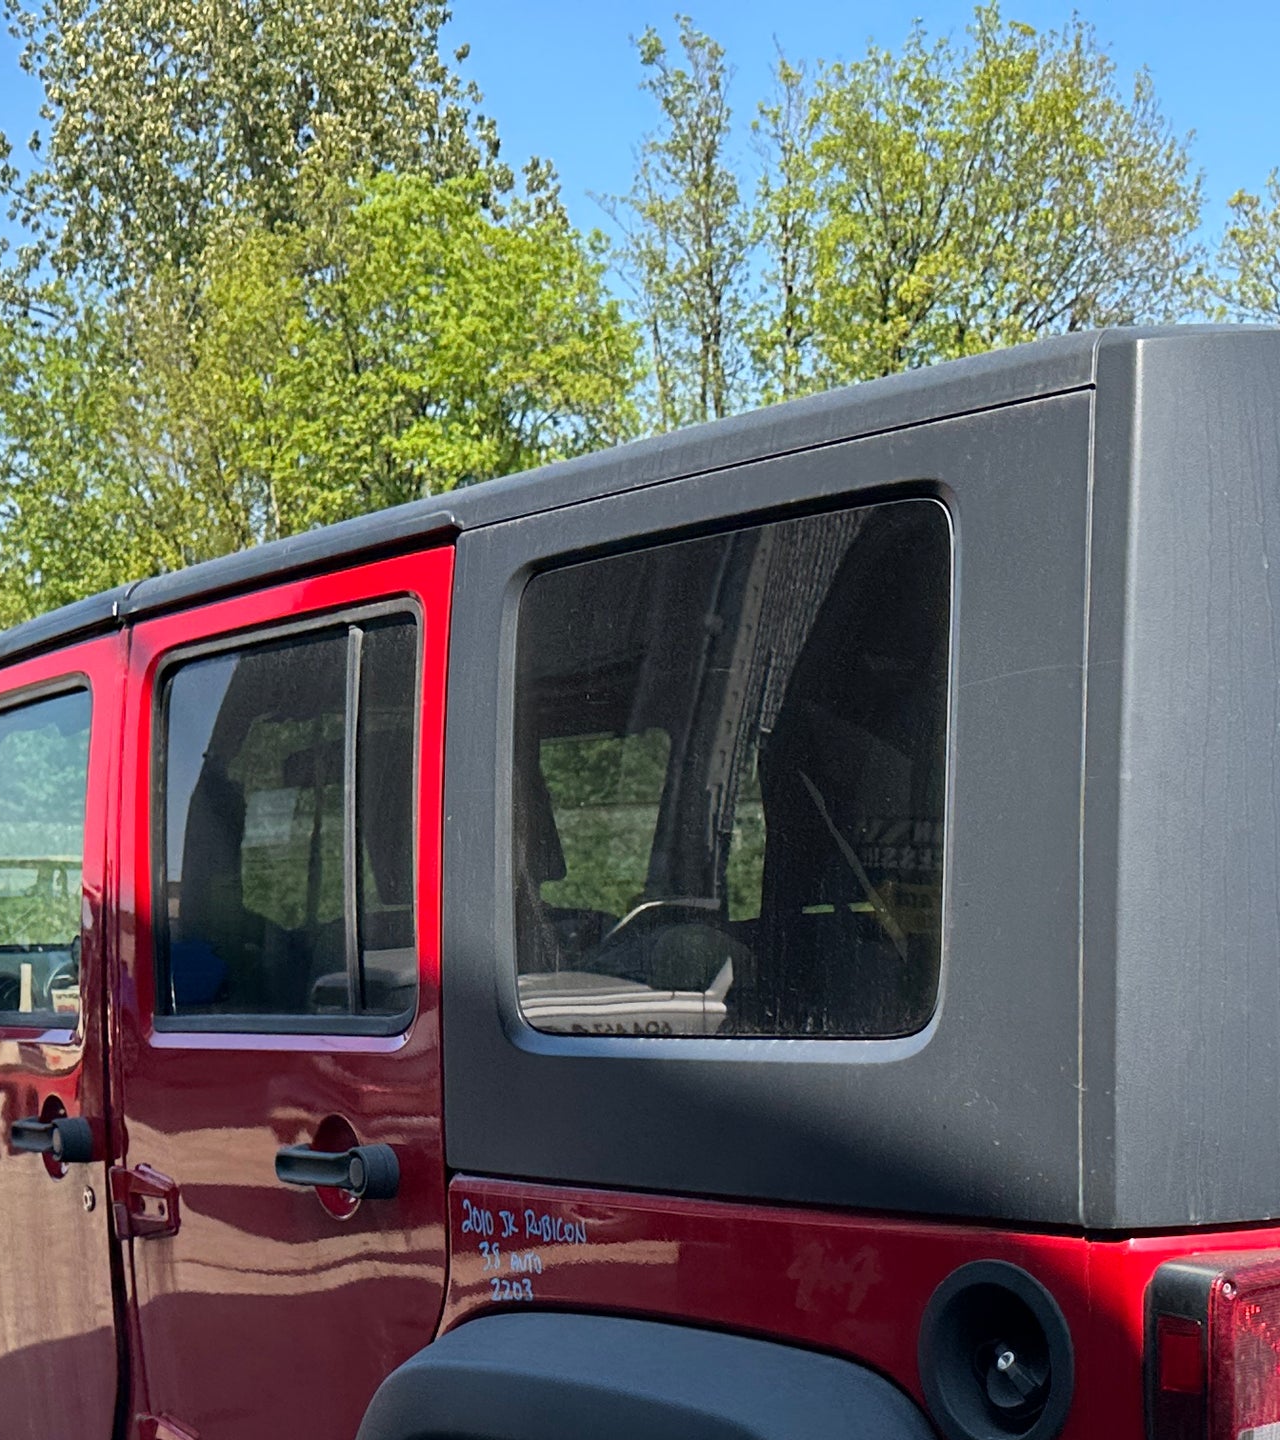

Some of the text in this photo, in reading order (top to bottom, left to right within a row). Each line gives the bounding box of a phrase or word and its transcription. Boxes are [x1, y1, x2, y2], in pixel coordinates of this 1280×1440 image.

[462, 1198, 495, 1236] 2010
[499, 1210, 518, 1238] JK
[511, 1250, 543, 1275] AUTO
[491, 1277, 534, 1301] 2203
